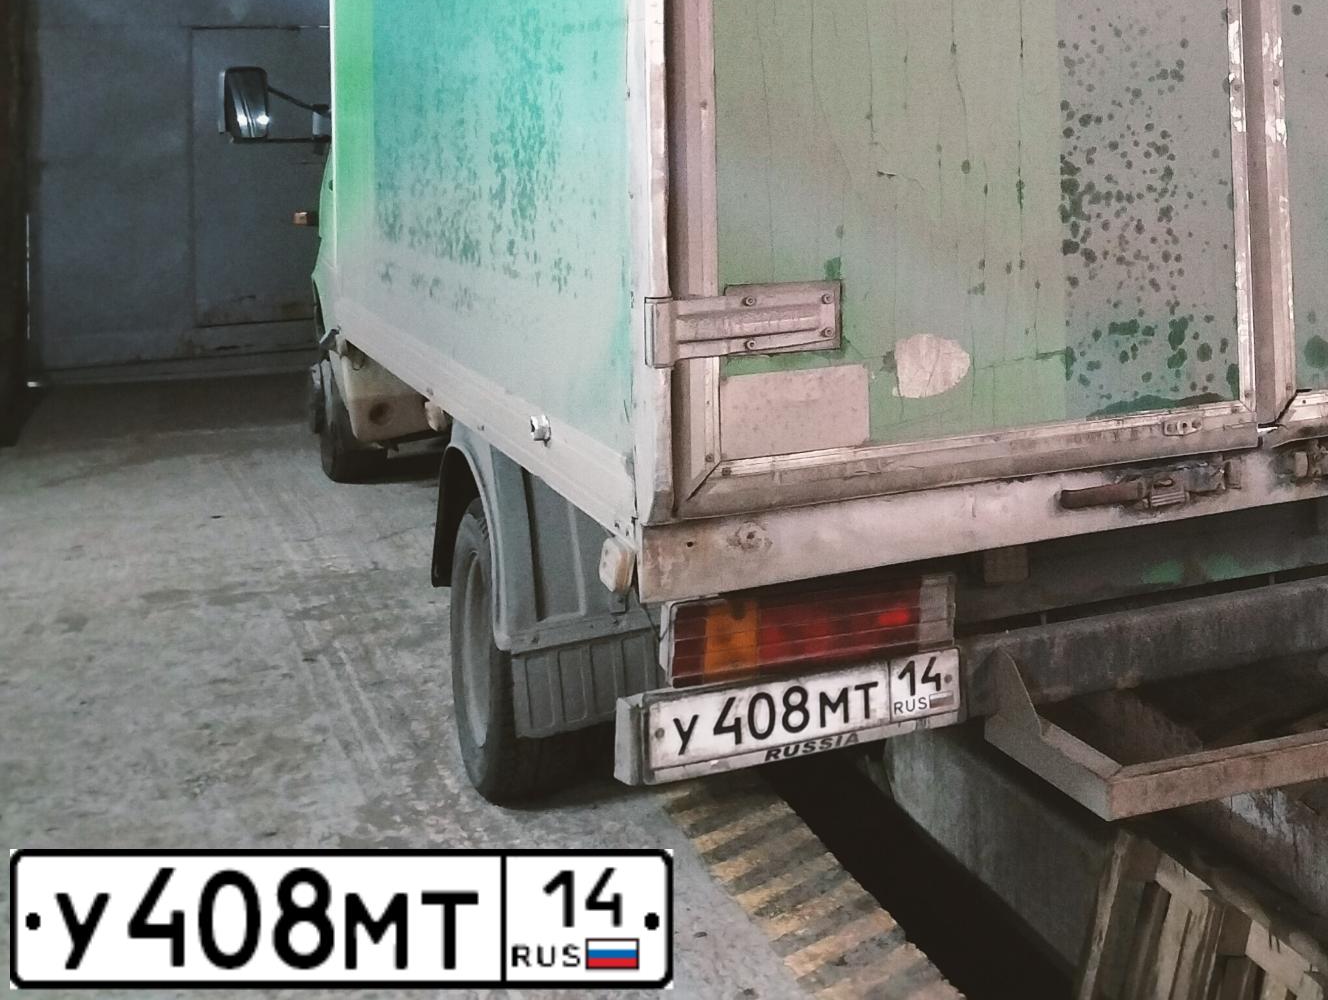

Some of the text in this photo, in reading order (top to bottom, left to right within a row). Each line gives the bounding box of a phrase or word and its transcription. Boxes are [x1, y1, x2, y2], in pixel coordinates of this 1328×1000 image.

[672, 656, 942, 755] У408МТ 14
[893, 698, 928, 714] RUS
[764, 732, 860, 762] RUSSIA
